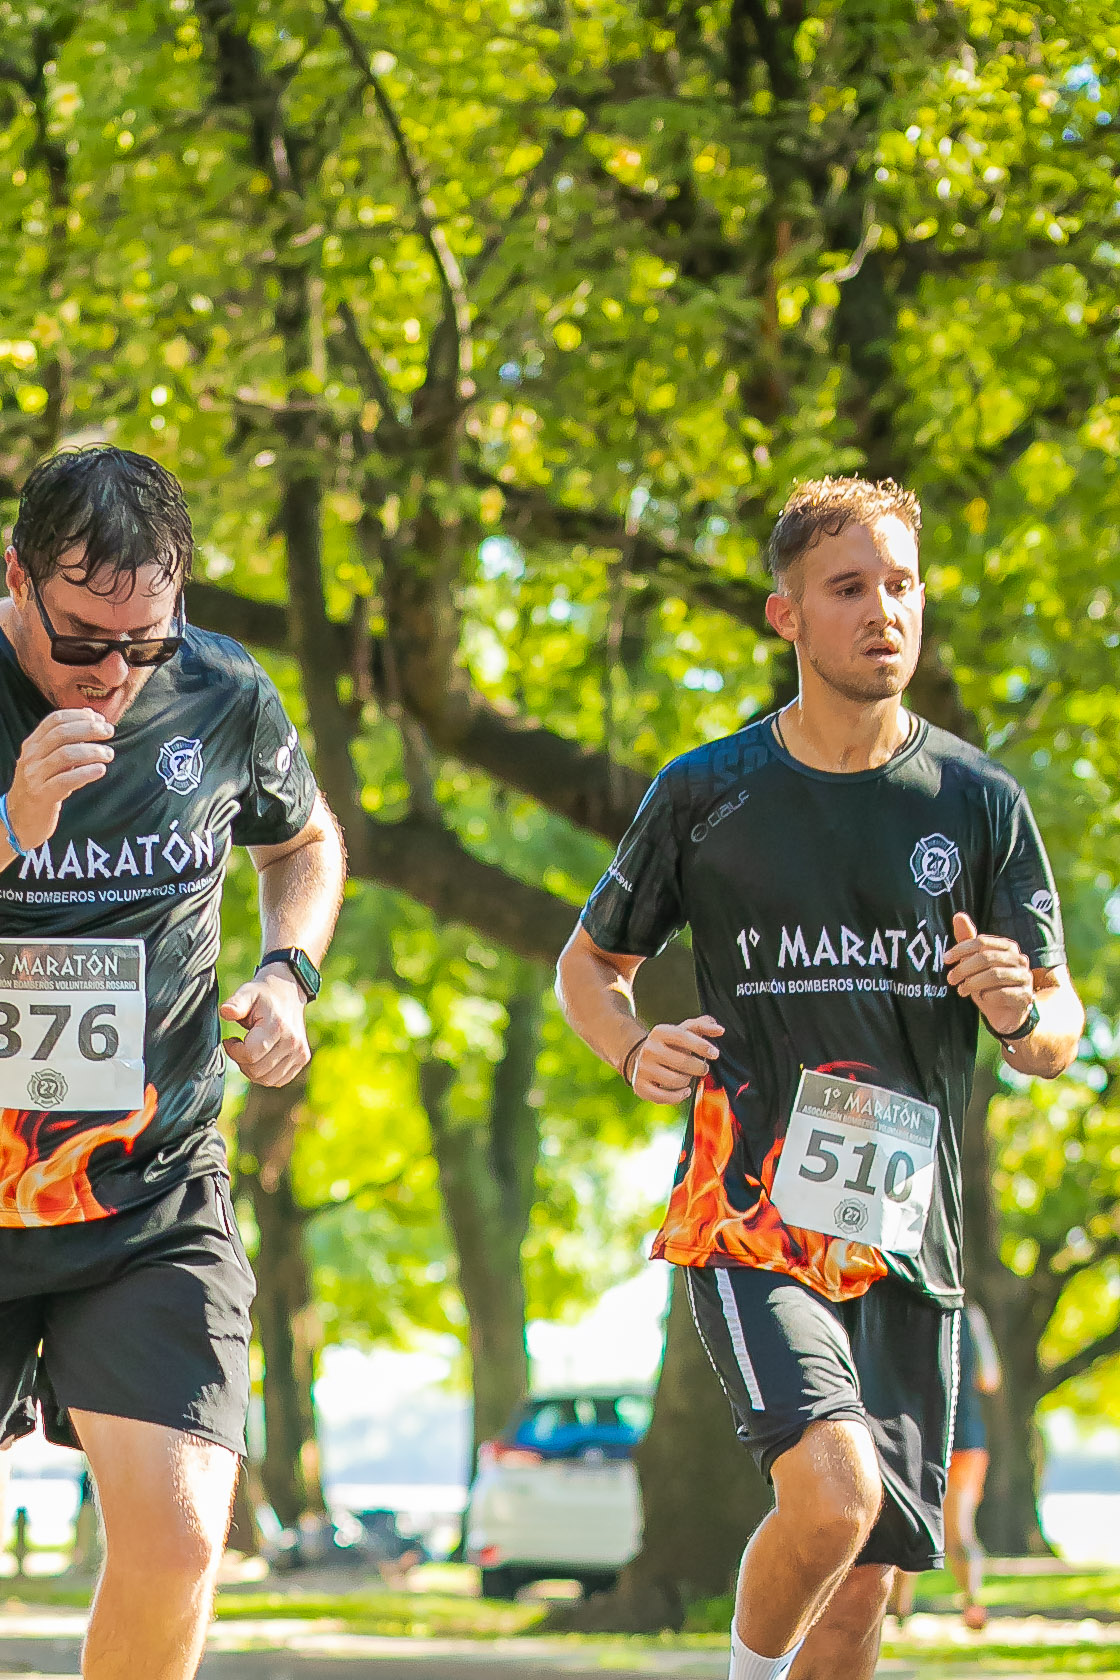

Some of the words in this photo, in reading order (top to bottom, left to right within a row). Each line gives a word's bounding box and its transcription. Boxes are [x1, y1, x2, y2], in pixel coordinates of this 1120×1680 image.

[18, 819, 214, 880] MARATÓN
[927, 852, 947, 872] 27
[26, 890, 96, 904] BOMBEROS
[778, 919, 949, 973] MARATÓN
[11, 949, 119, 977] MARATÓN
[13, 979, 55, 990] BOMBEROS
[55, 980, 106, 991] VOLUNTARIOS
[105, 980, 137, 991] ROSARIO
[788, 978, 854, 994] BOMBEROS
[844, 1092, 921, 1130] MARATÓN
[798, 1128, 916, 1203] 510
[843, 1206, 861, 1221] 27
